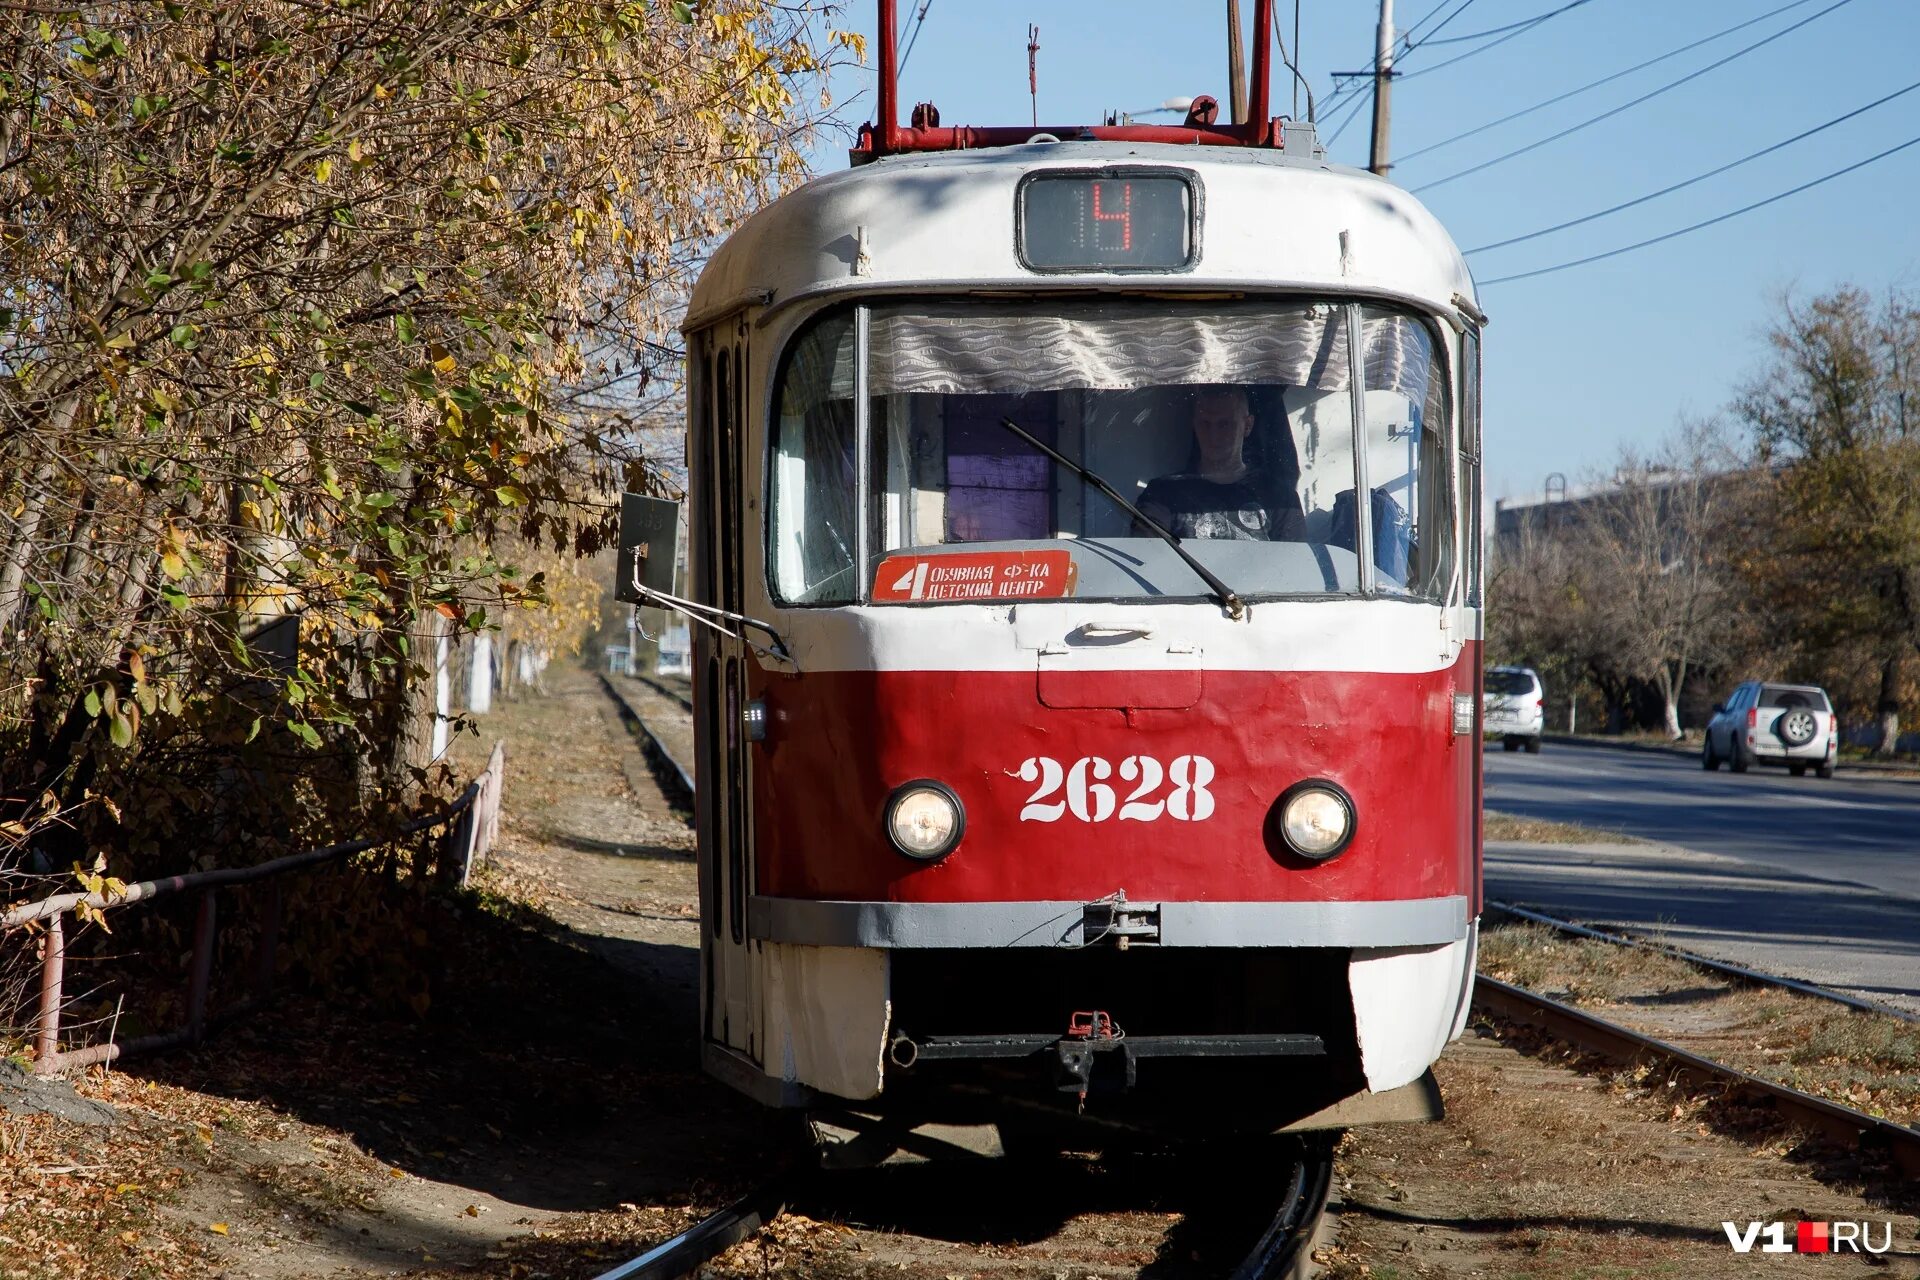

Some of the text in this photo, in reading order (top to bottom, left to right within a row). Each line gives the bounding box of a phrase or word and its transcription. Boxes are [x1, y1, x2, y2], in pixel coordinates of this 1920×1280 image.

[1092, 183, 1133, 251] 4
[892, 562, 929, 600] 4
[926, 580, 1045, 600] ДЕТСКИЙ ЦЕНТР
[930, 563, 1050, 583] ОБУВНАЯ Ф-КА
[1019, 755, 1215, 822] 2628
